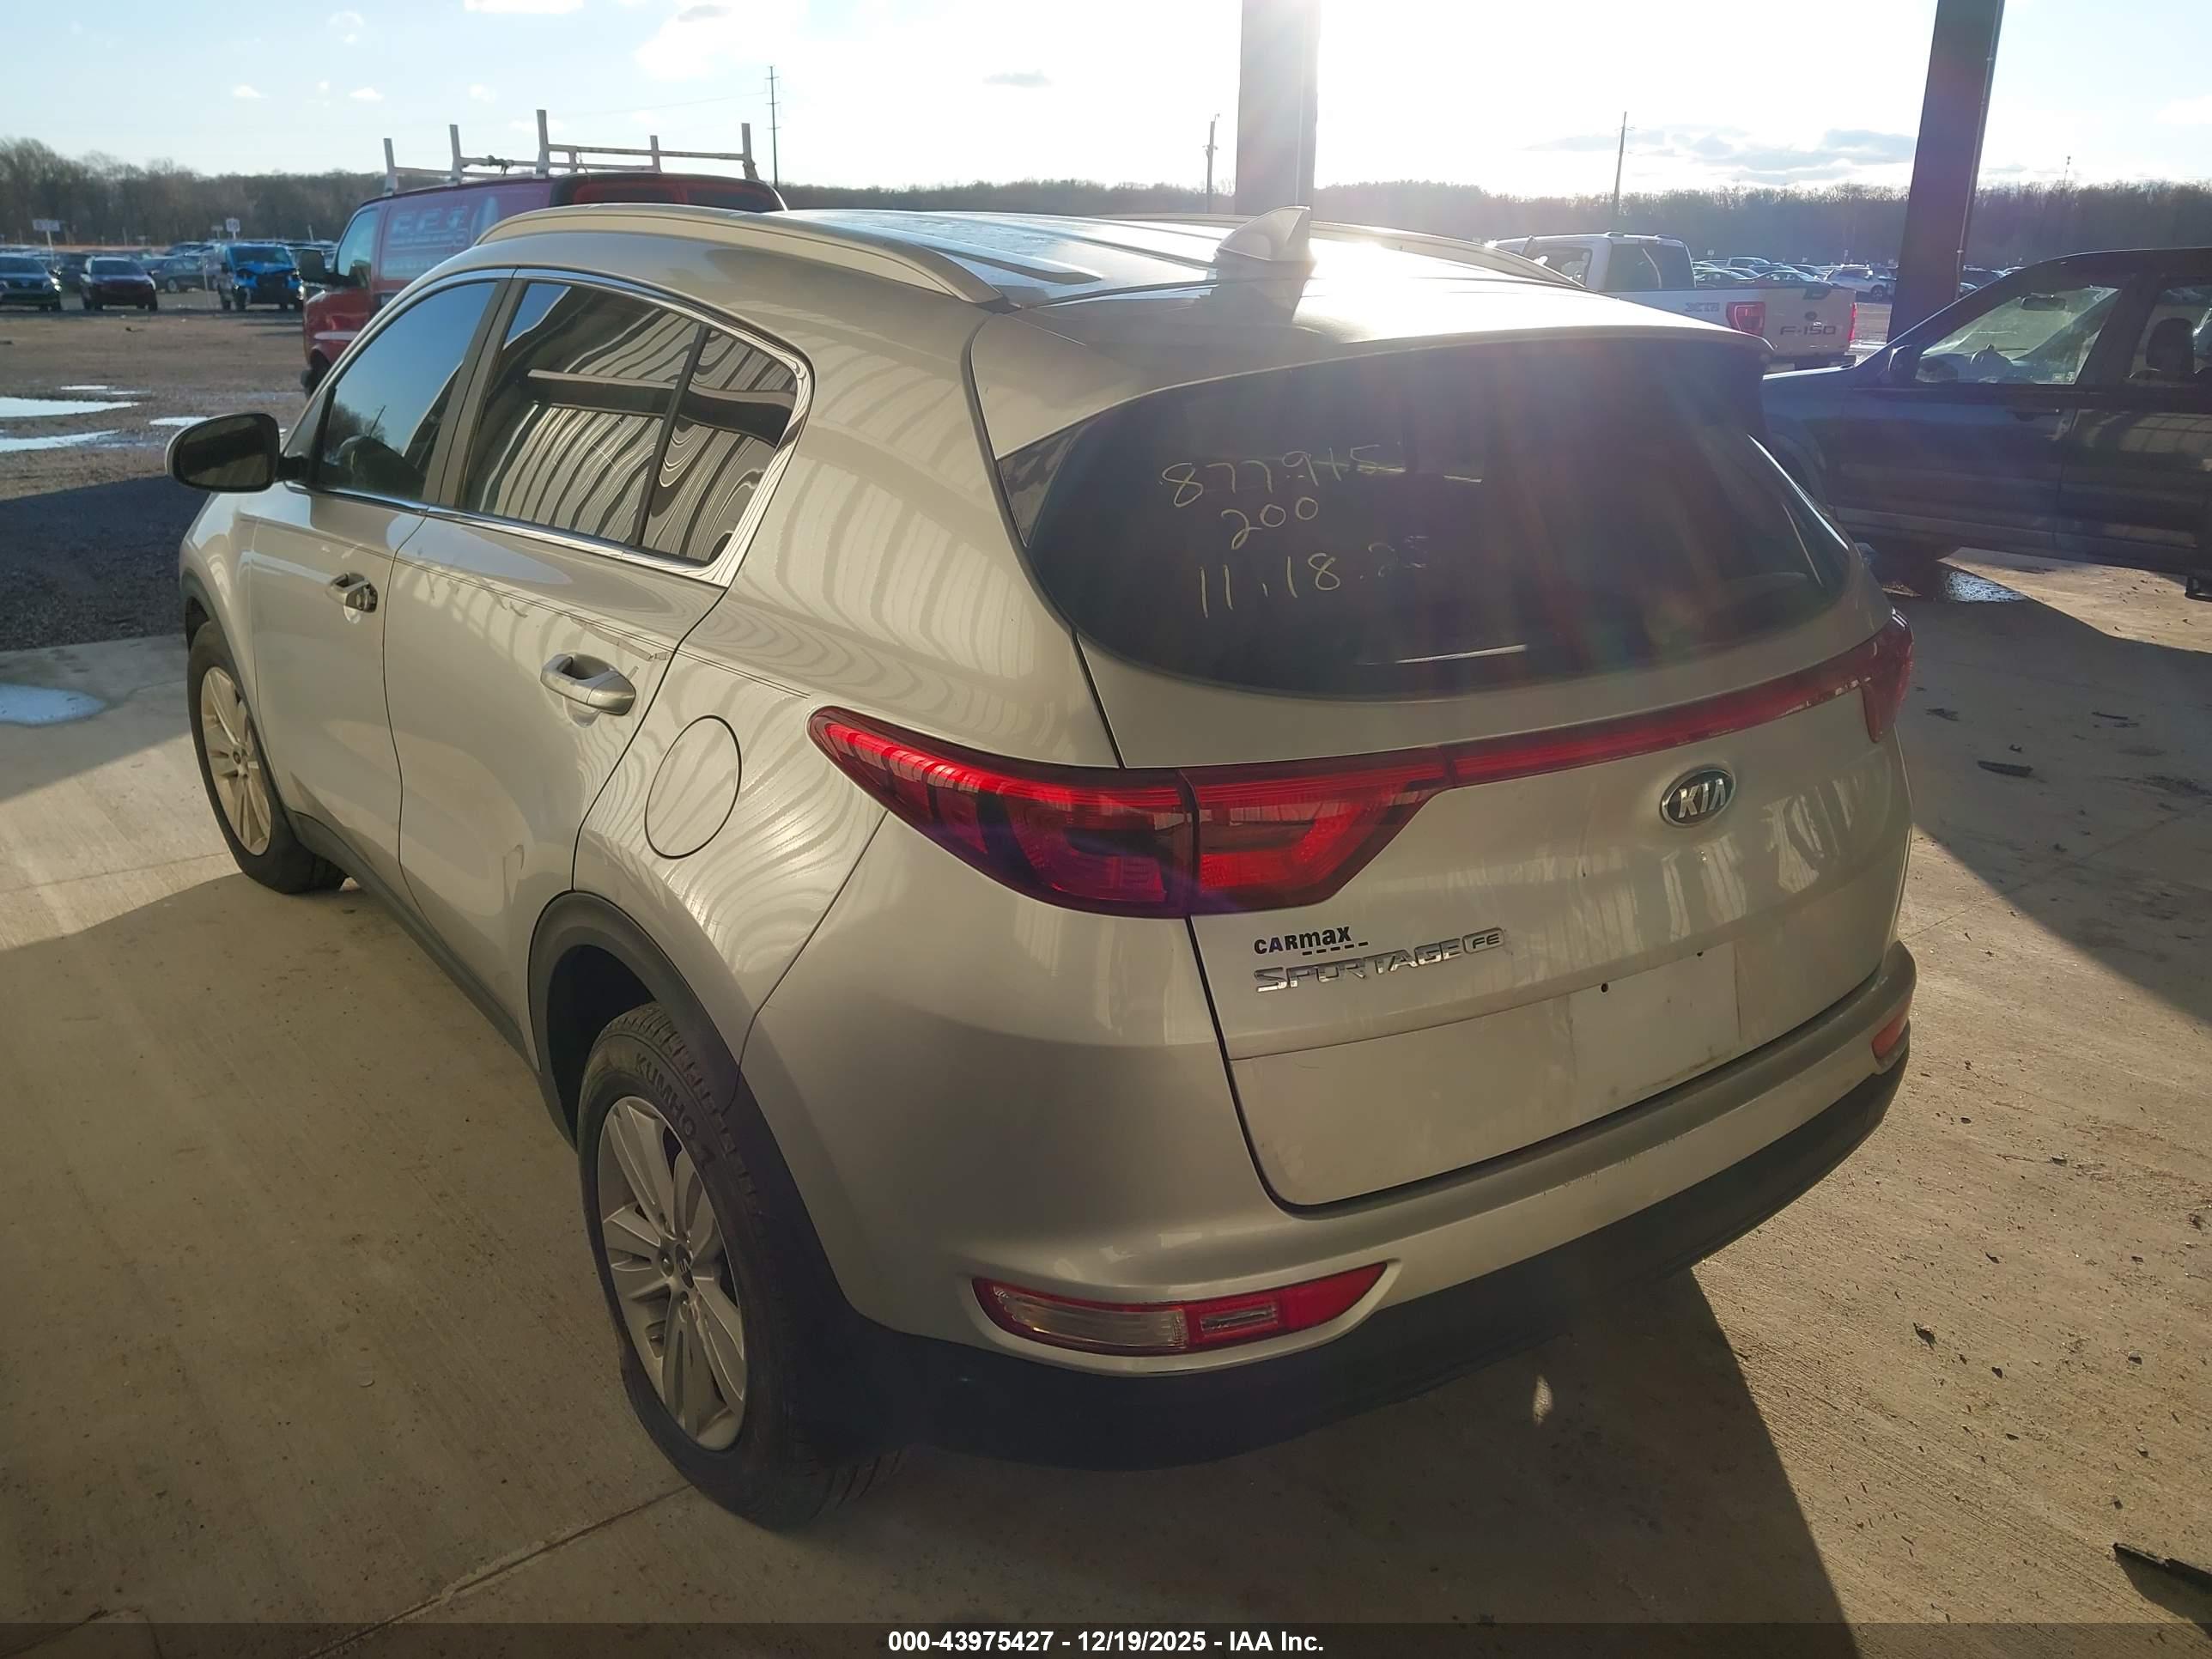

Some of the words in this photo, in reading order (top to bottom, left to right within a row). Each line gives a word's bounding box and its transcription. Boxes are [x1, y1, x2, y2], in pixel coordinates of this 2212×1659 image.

[1779, 325, 1837, 336] F-150
[1220, 496, 1319, 550] 200
[1678, 777, 1726, 818] KIA
[1253, 938, 1463, 994] SPORTAGE
[1468, 931, 1503, 951] FE
[635, 1052, 696, 1137] KUMHO
